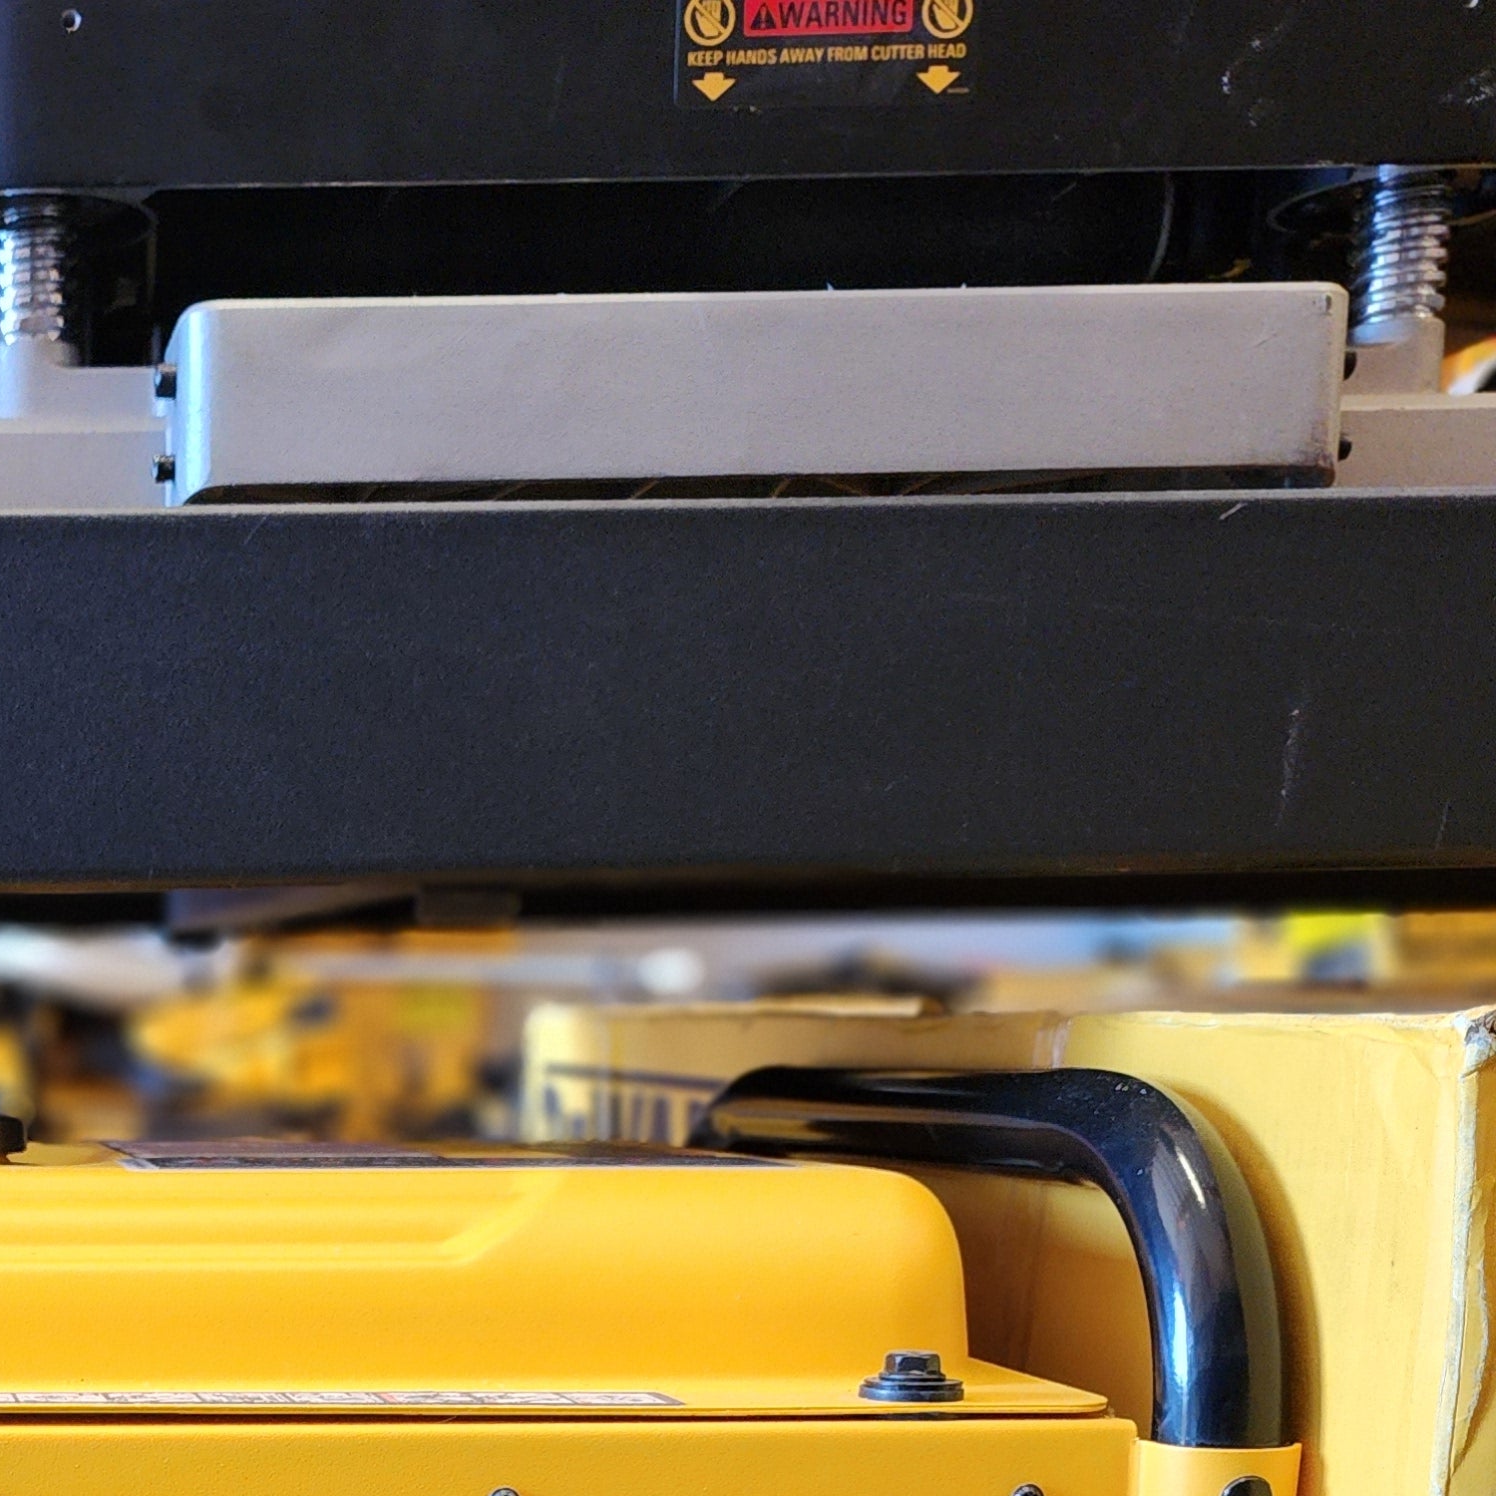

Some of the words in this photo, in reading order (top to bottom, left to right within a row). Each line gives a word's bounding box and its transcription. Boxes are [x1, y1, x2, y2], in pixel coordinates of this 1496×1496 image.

[778, 0, 907, 29] WARNING
[687, 49, 723, 67] KEEP
[726, 48, 778, 66] HANDS
[779, 47, 824, 65] AWAY
[826, 45, 869, 63] FROM
[871, 44, 925, 62] CUTTER
[927, 43, 968, 60] HEAD
